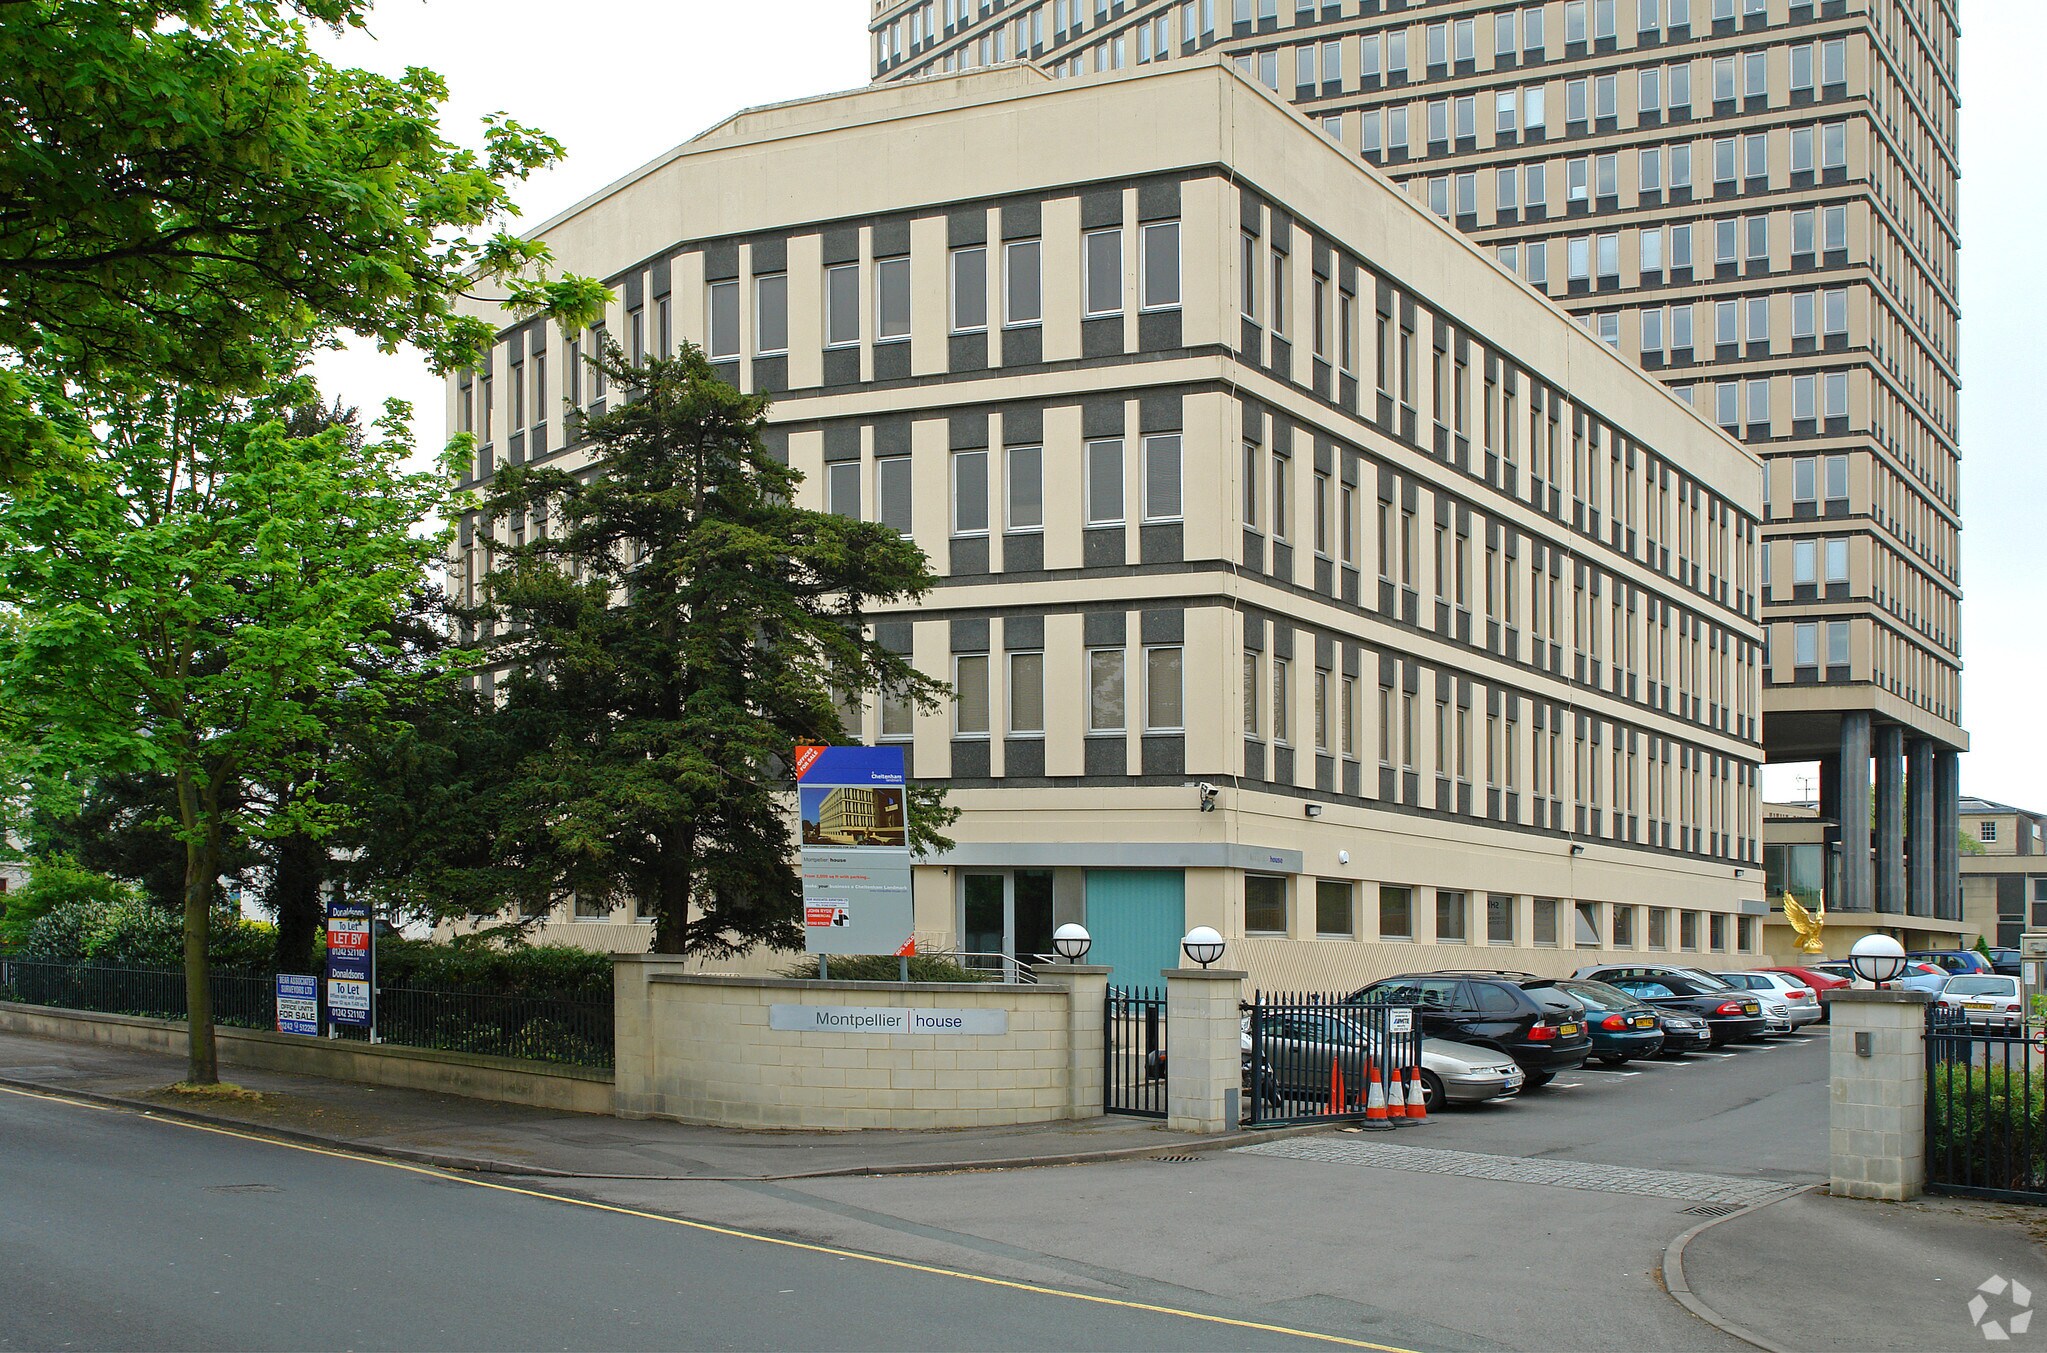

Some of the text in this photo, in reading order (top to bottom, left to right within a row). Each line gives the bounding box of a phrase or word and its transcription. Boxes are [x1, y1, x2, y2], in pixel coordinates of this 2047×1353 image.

[797, 747, 813, 766] OFFICES
[800, 750, 819, 772] FOR SALE
[332, 907, 365, 917] Donaldsons
[339, 920, 358, 930] To Let
[333, 932, 362, 945] LET BY
[331, 947, 346, 956] 01242
[332, 968, 365, 979] Donaldsons
[290, 977, 315, 986] ASSOCIATES
[281, 985, 305, 994] SURVEYORS
[336, 983, 360, 995] To Let
[279, 1010, 316, 1021] FOR SALE
[331, 1008, 366, 1019] 01242 521102
[816, 1011, 962, 1029] Montpellier house
